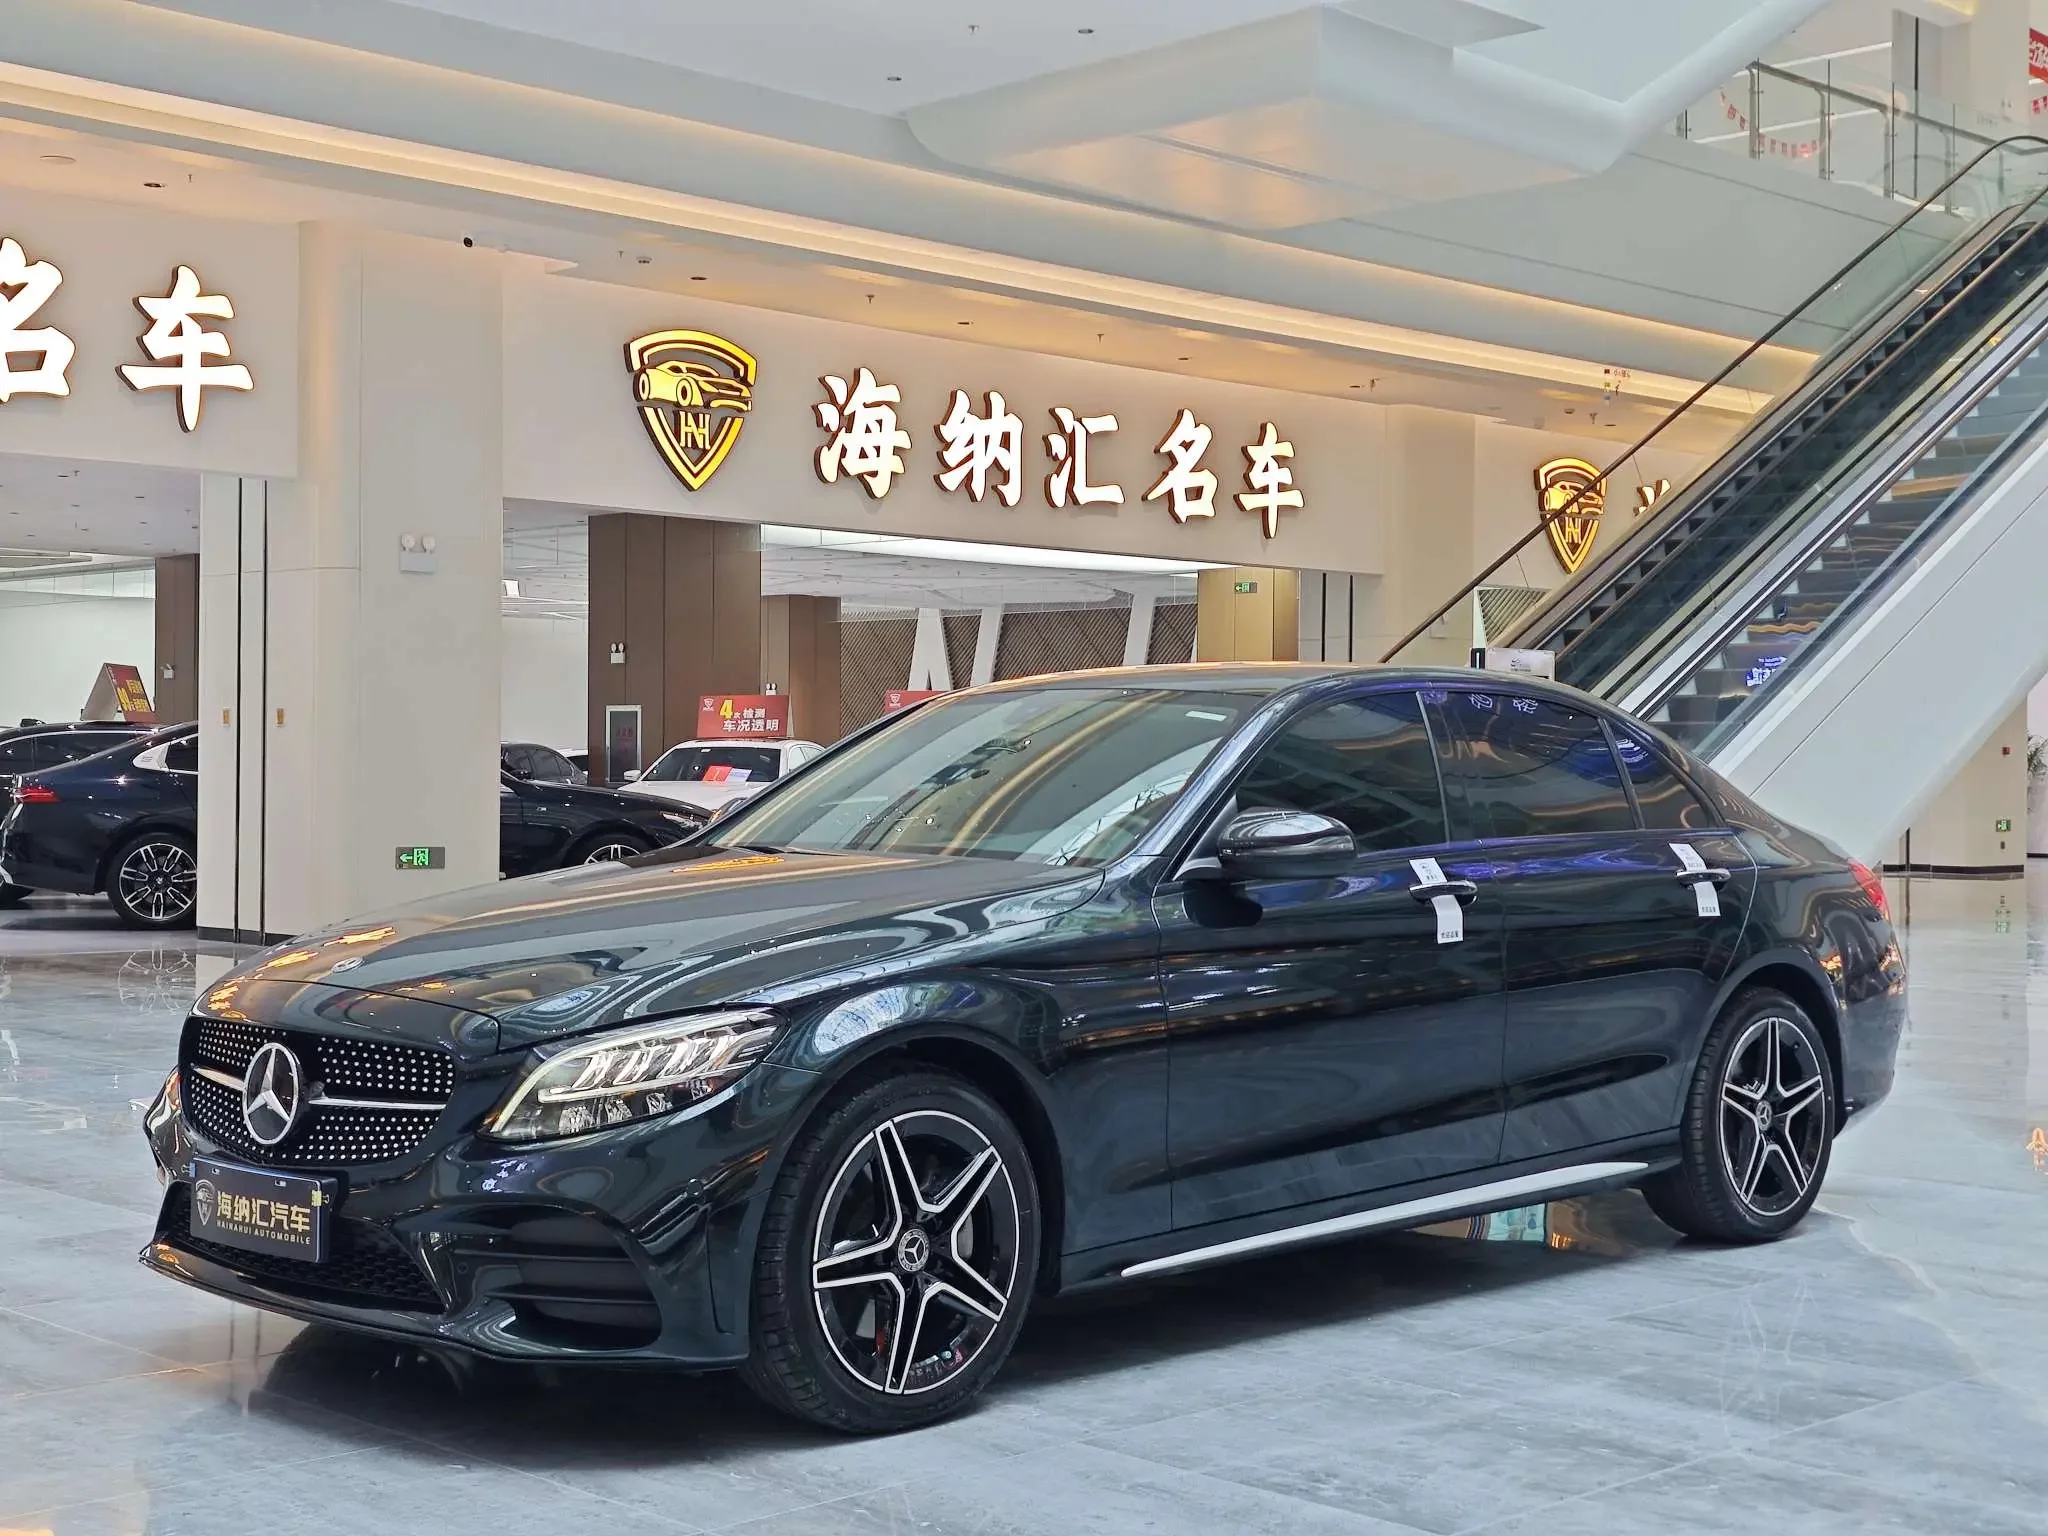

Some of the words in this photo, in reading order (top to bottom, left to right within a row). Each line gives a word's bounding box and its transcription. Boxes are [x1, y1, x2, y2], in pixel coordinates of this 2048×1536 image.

[0, 236, 255, 433] 名车
[812, 367, 1305, 539] 海纳汇名车
[722, 719, 779, 732] 车况透明
[216, 1190, 311, 1233] 海纳汇汽车
[254, 1228, 311, 1245] AUTOMOBILE
